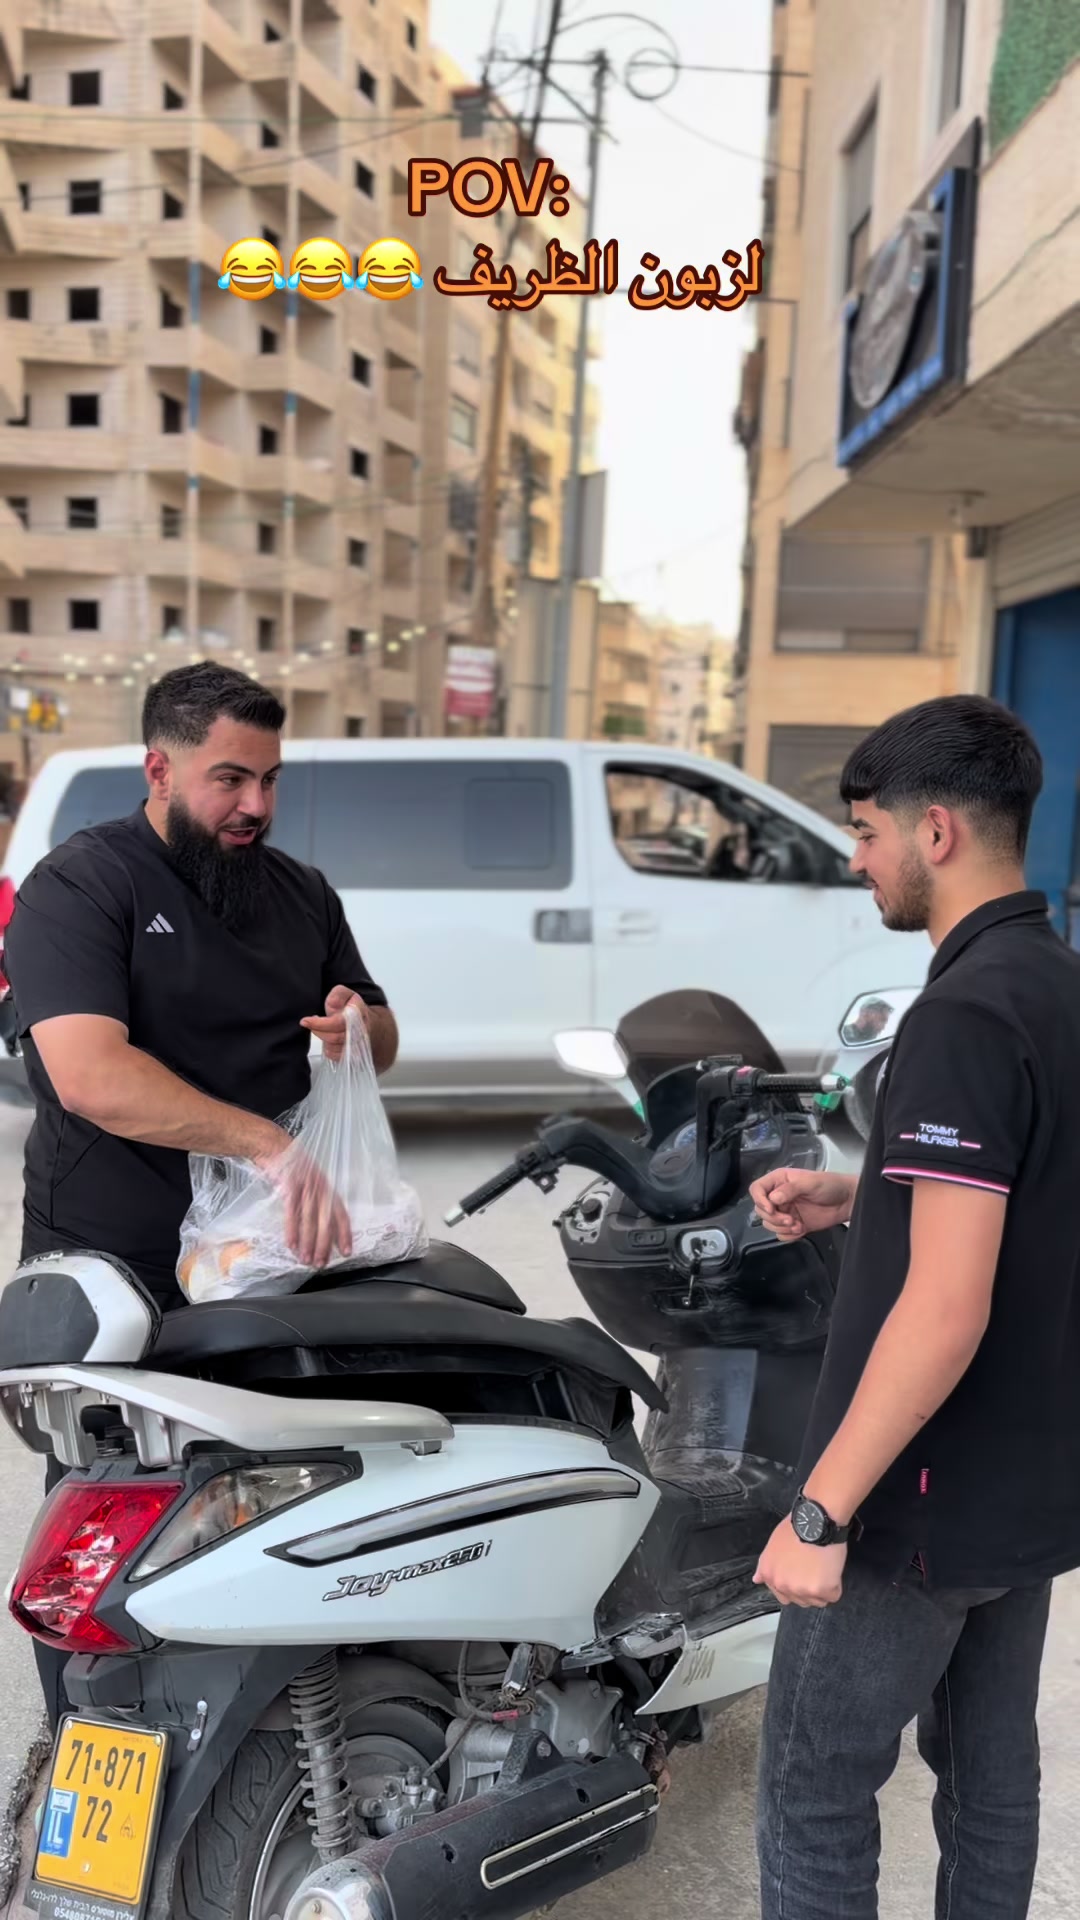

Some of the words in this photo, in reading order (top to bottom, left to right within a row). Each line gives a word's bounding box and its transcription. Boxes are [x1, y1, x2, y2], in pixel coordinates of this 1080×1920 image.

[915, 1132, 960, 1148] HILFIGER
[919, 1123, 959, 1137] TOMMY
[47, 1810, 63, 1845] IL
[82, 1795, 113, 1843] 72
